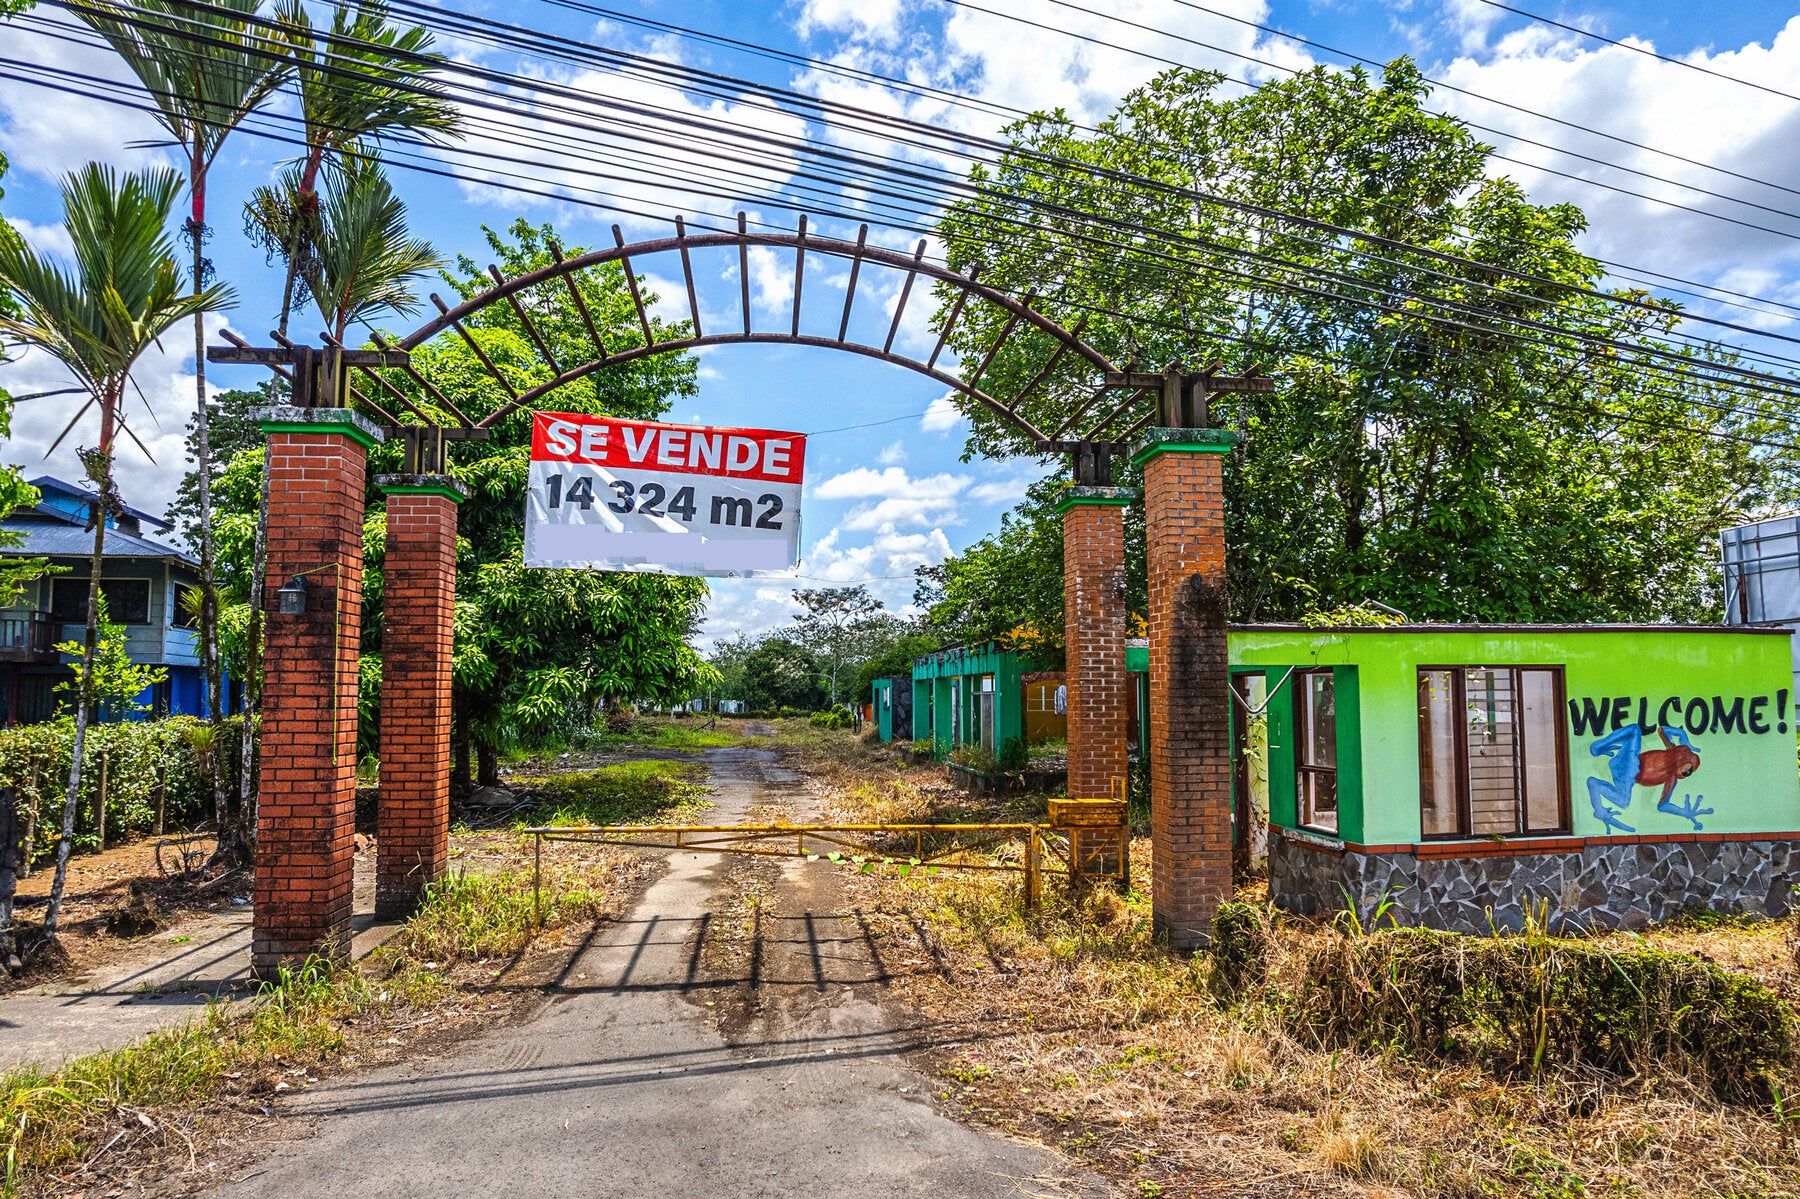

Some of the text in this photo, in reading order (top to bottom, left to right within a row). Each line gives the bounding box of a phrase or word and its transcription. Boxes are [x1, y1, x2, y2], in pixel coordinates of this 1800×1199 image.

[545, 420, 792, 476] SE VENDE
[546, 474, 784, 531] 14 324 m2
[1568, 688, 1788, 737] WELCOME!
